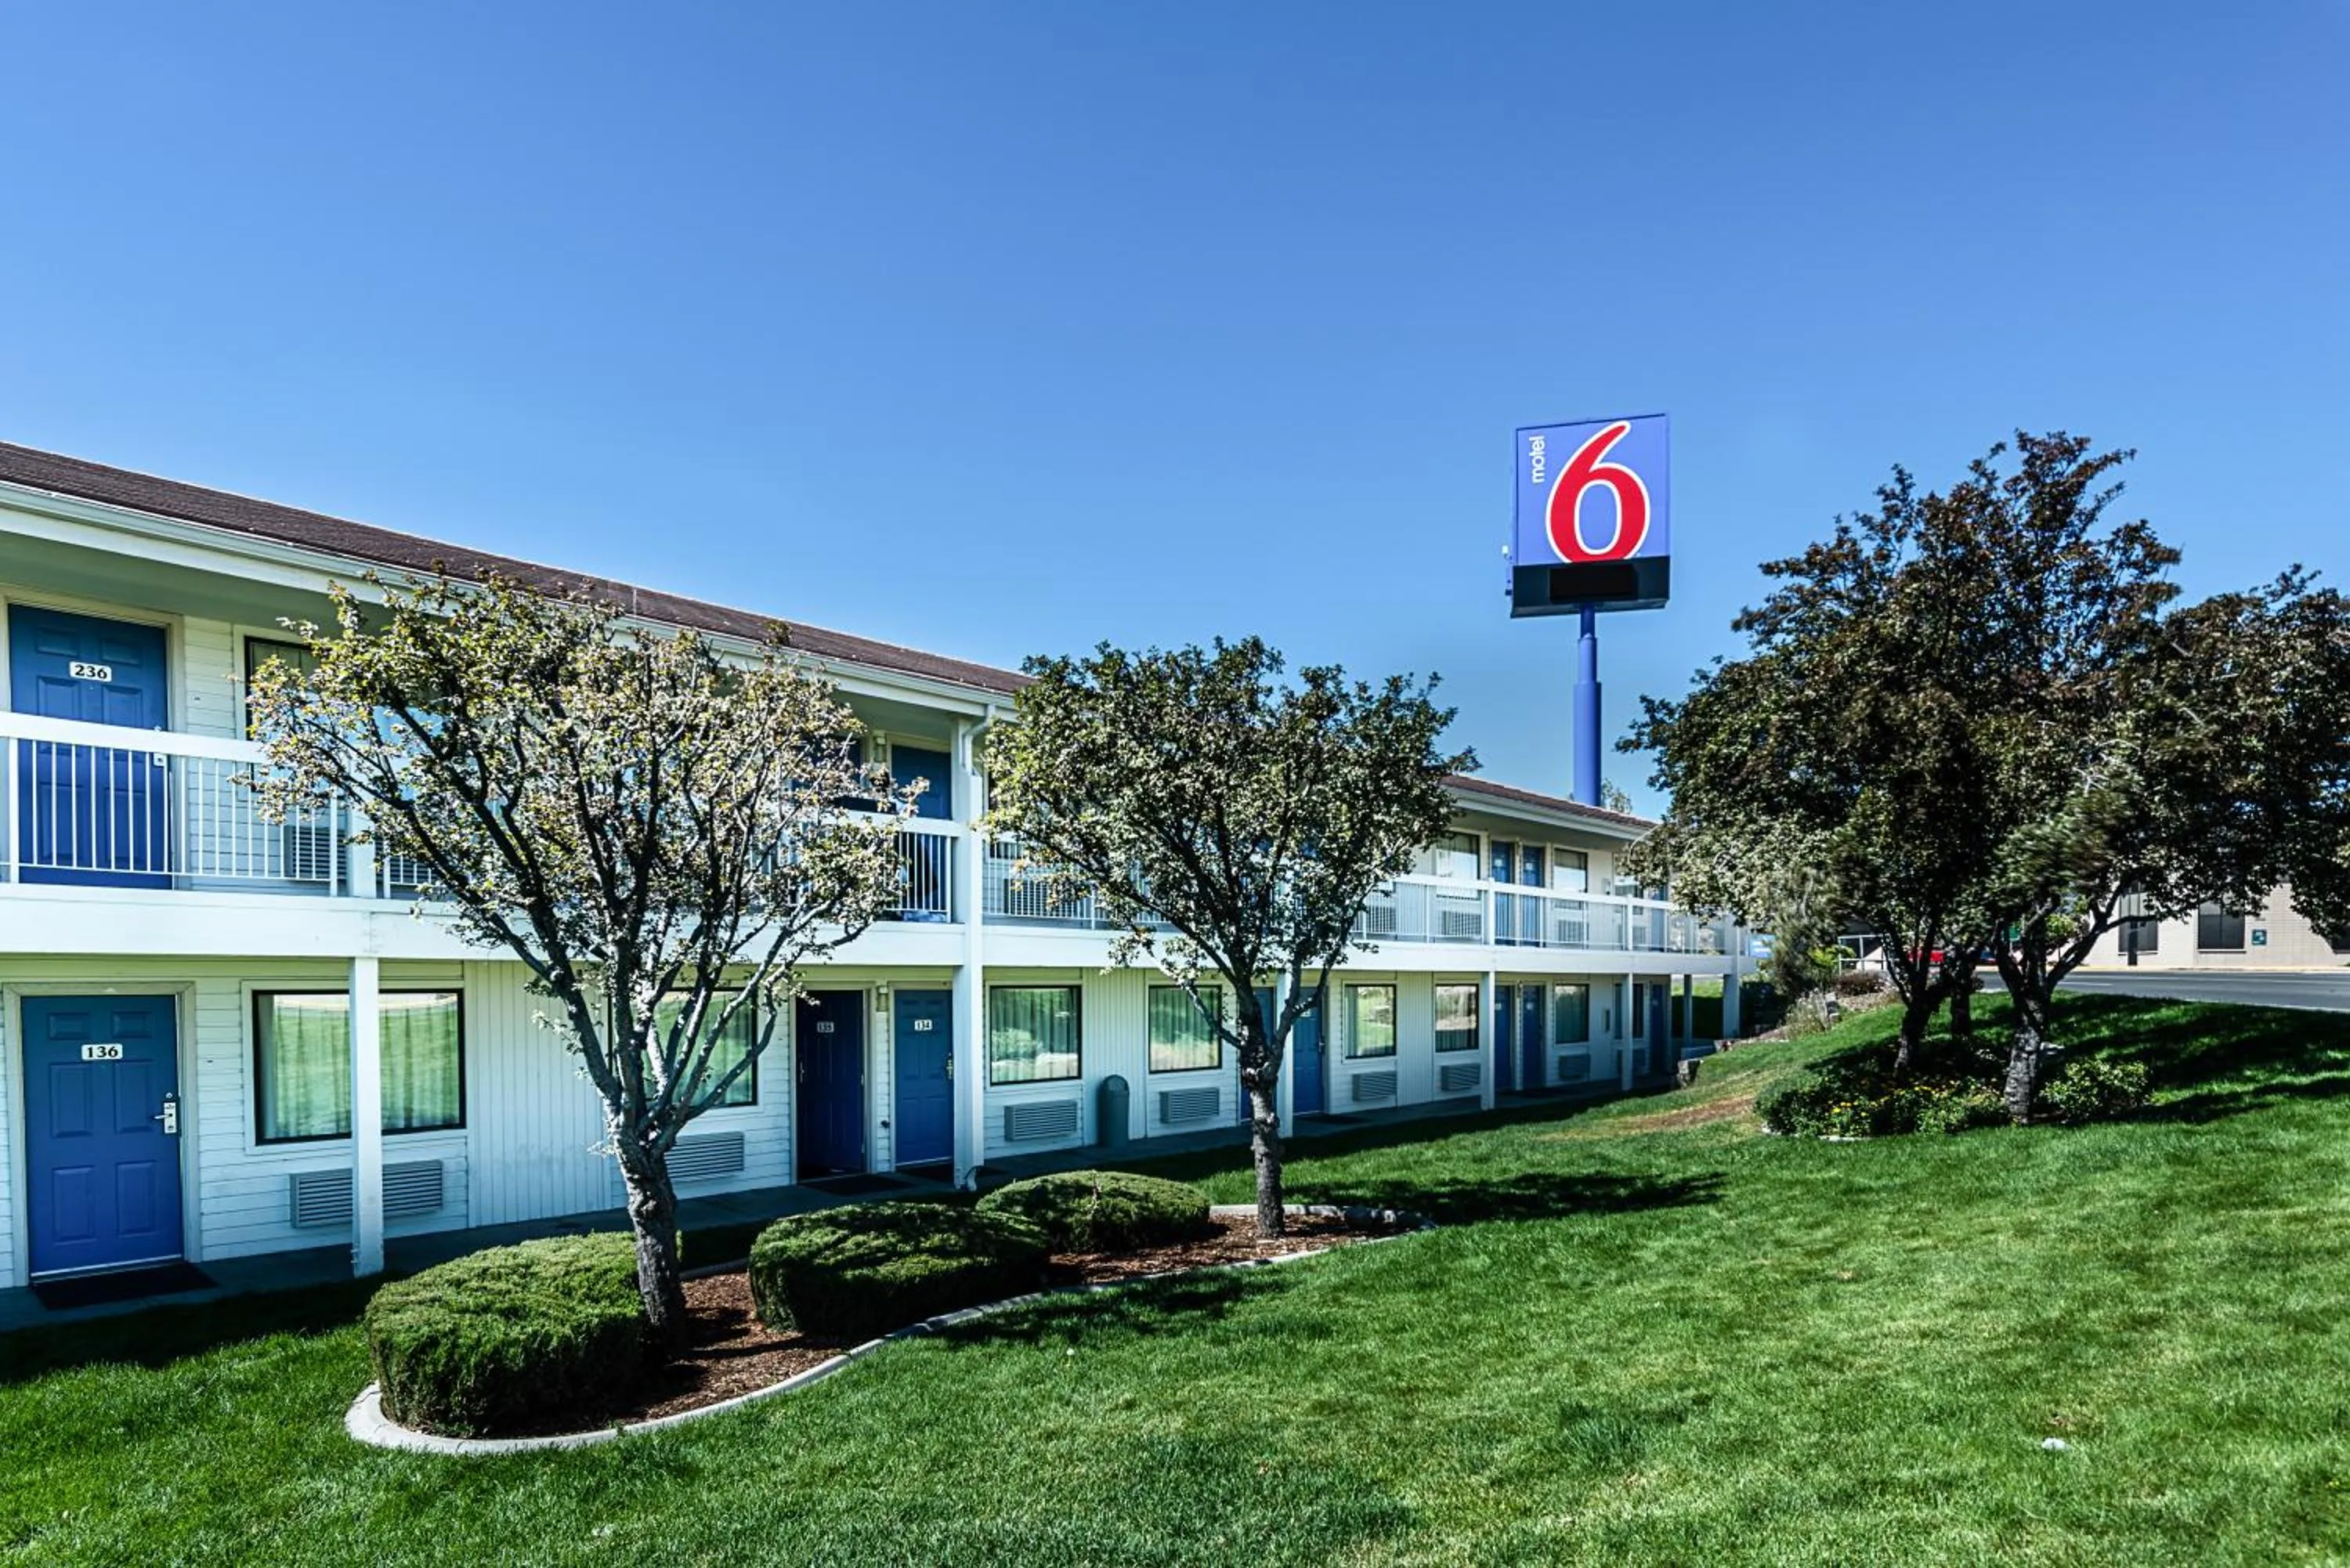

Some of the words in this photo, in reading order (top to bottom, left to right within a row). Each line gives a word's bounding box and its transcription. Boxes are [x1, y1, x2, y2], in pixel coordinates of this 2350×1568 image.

[1529, 435, 1546, 483] motel
[1546, 421, 1650, 563] 6
[74, 664, 107, 679] 236
[87, 1046, 118, 1058] 136
